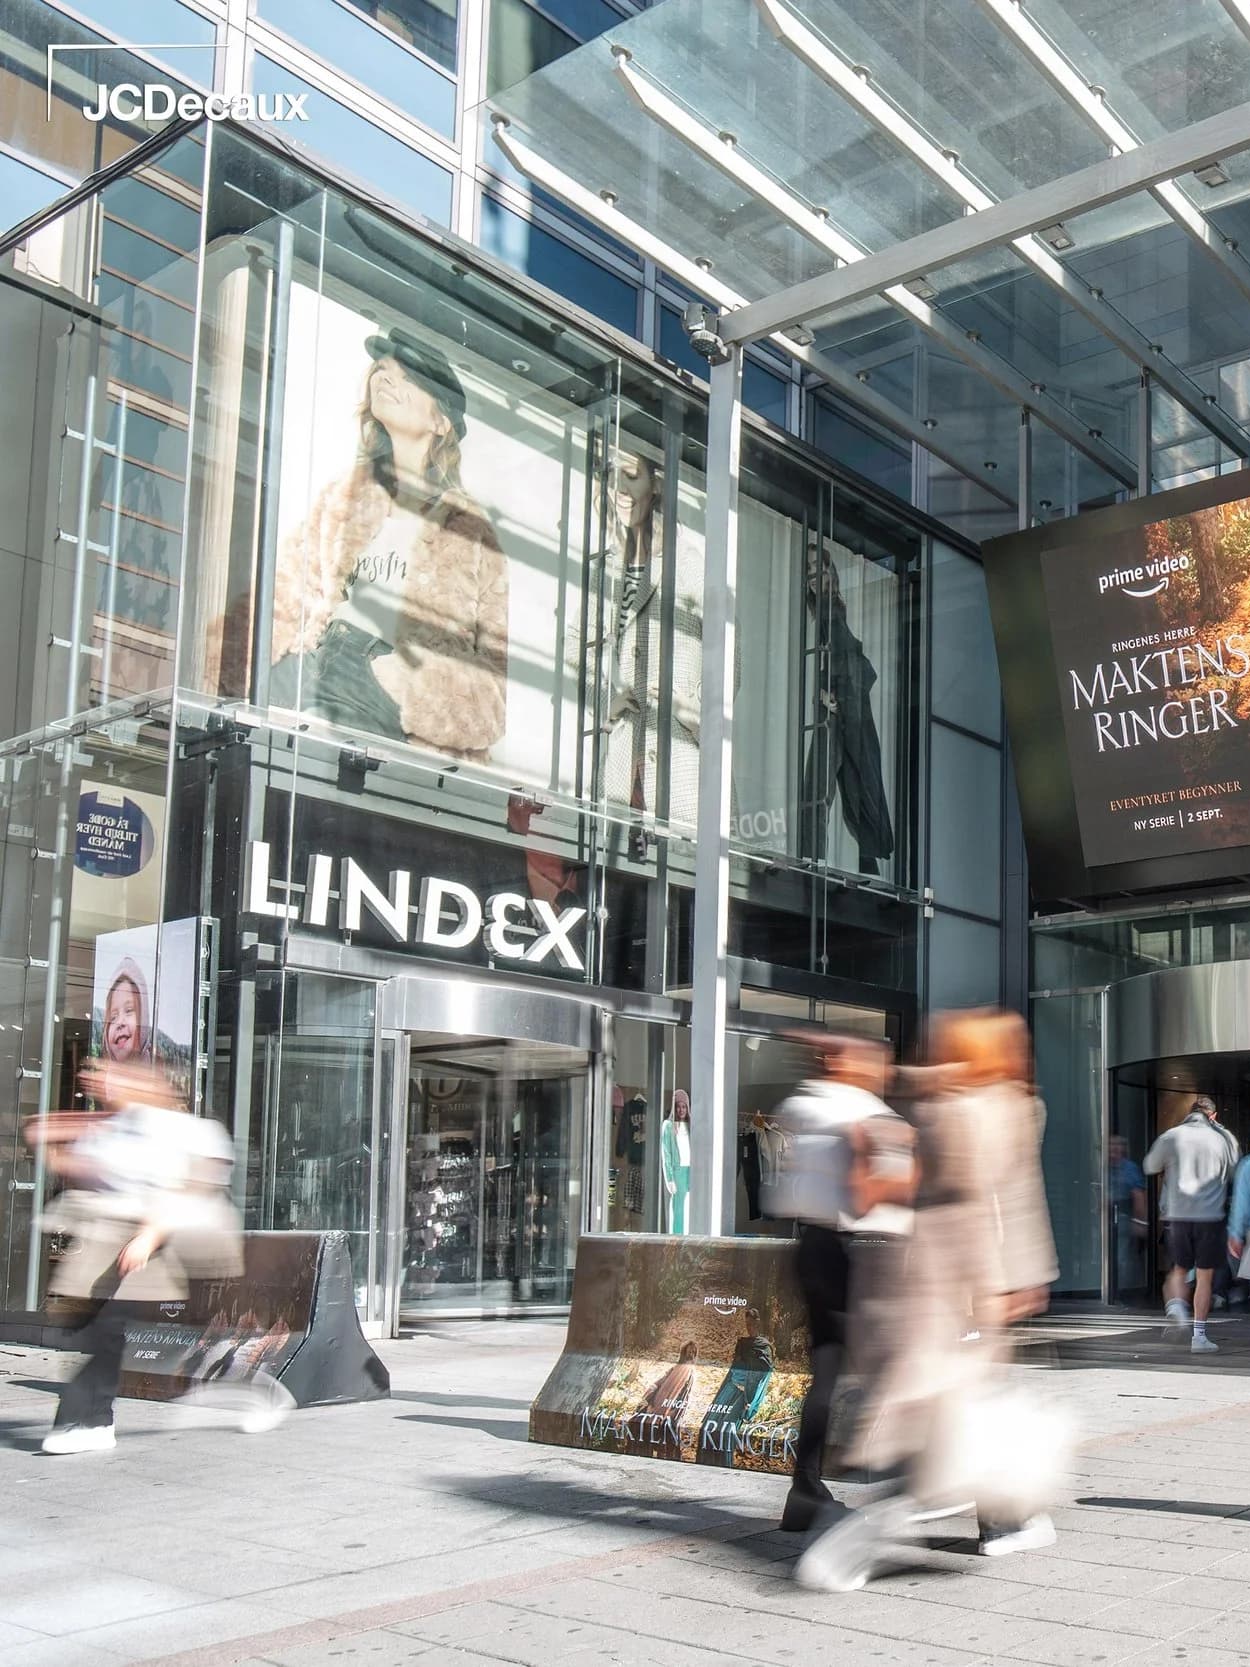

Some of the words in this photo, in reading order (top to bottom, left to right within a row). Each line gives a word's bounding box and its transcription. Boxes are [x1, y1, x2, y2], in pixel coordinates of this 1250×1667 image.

[1098, 568, 1144, 594] prime
[1145, 556, 1190, 578] video
[1111, 633, 1160, 653] RINGENES
[1163, 625, 1196, 641] HERRE
[1068, 634, 1250, 710] MAKTENS
[1093, 688, 1239, 753] RINGER
[1109, 791, 1176, 812] EVENTYRET
[1178, 780, 1242, 801] BEGYNNER
[1133, 820, 1147, 831] NY
[1149, 815, 1175, 828] SERIE
[1187, 812, 1194, 823] 2
[1196, 808, 1224, 822] SEPT.
[242, 840, 587, 970] LINDEX
[703, 1295, 726, 1307] prime
[727, 1295, 748, 1307] video
[580, 1406, 693, 1446] MAKTENS
[703, 1420, 799, 1462] RINGER
